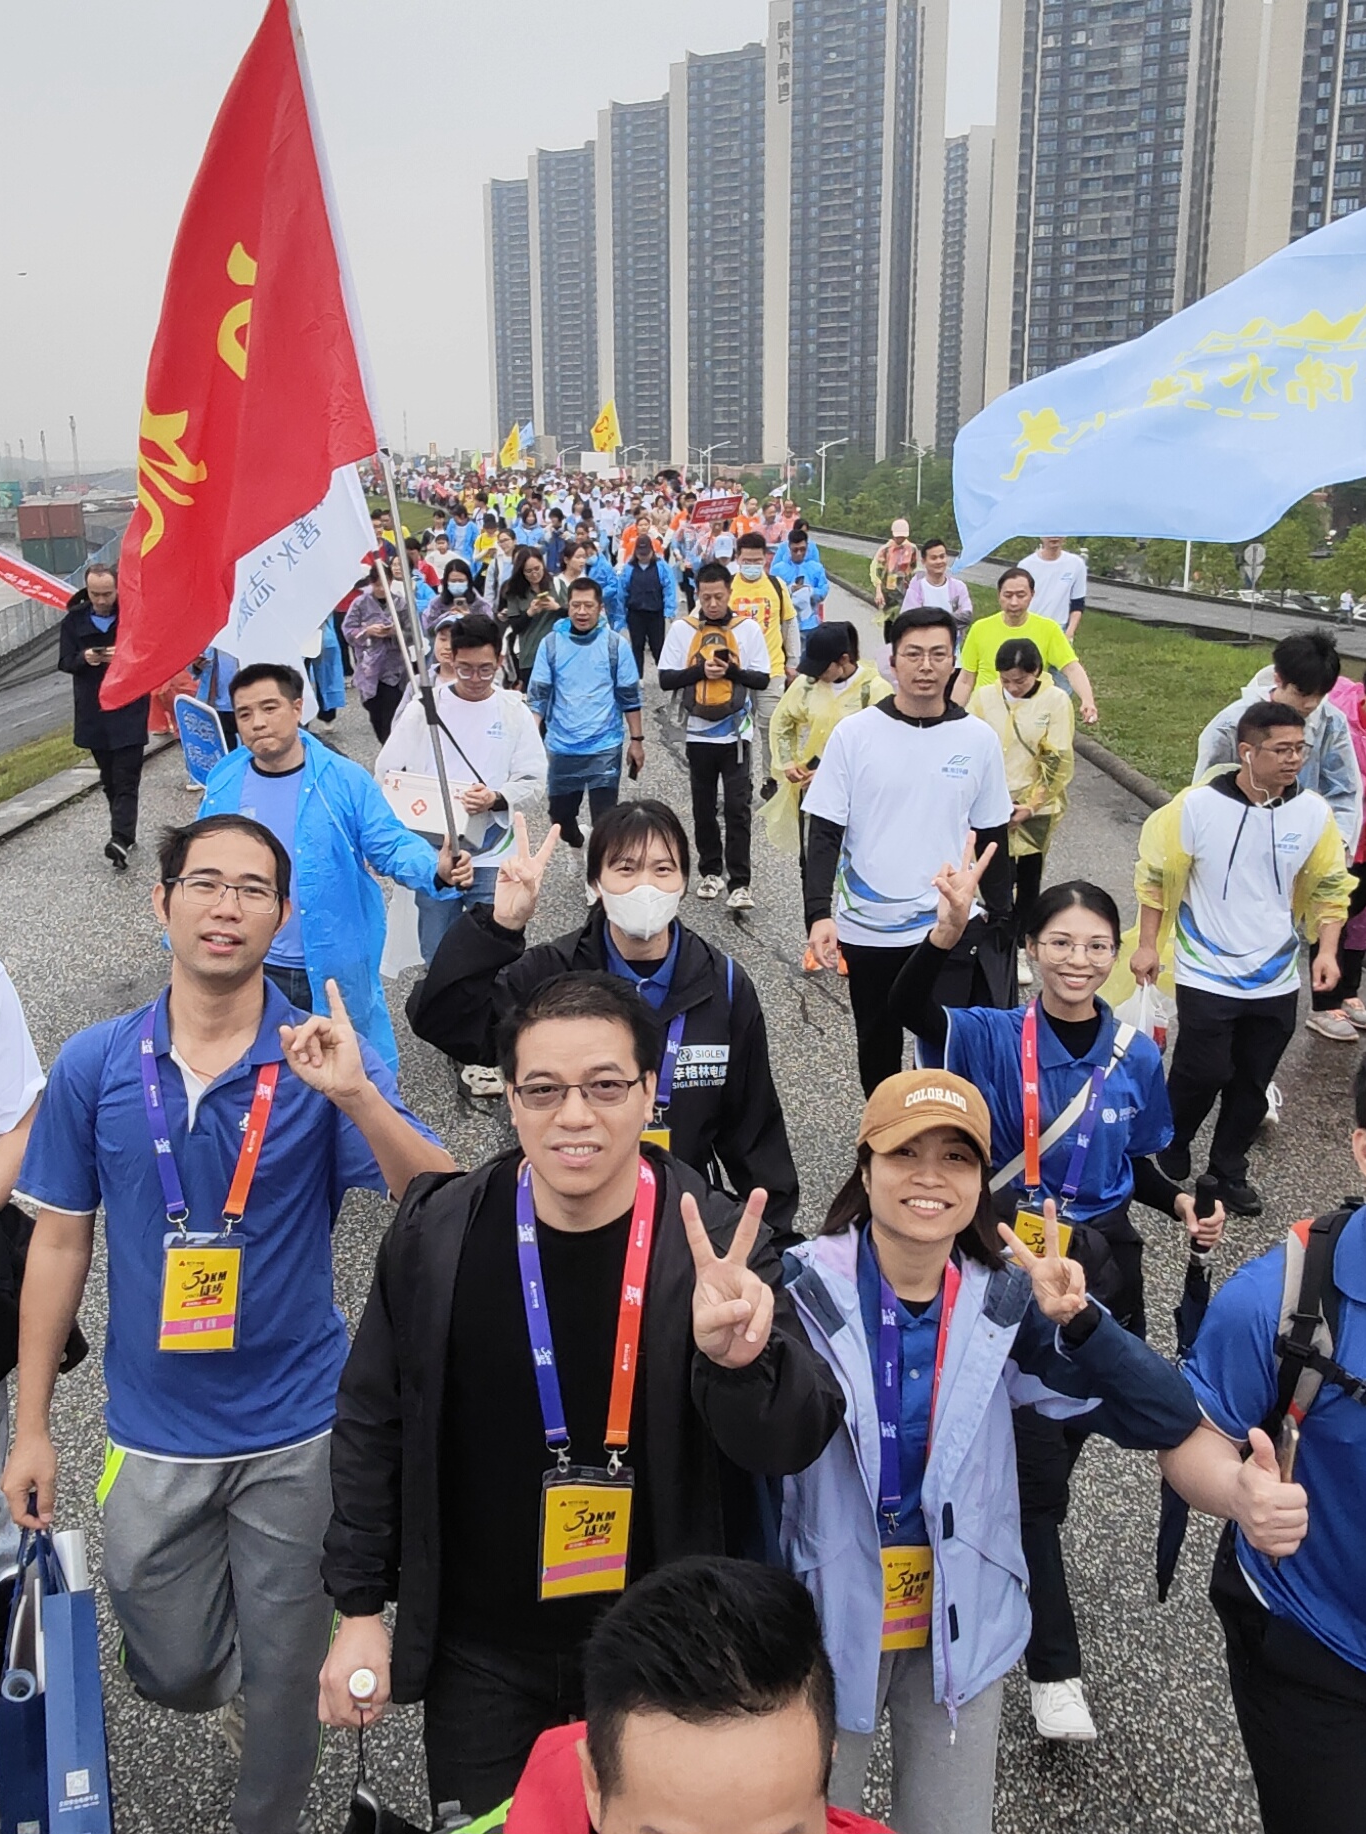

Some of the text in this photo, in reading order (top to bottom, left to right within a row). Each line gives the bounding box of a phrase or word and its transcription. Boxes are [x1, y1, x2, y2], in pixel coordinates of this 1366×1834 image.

[695, 1049, 725, 1058] SIGLEN
[672, 1080, 699, 1090] SIGLEN
[904, 1087, 967, 1112] COLORADO
